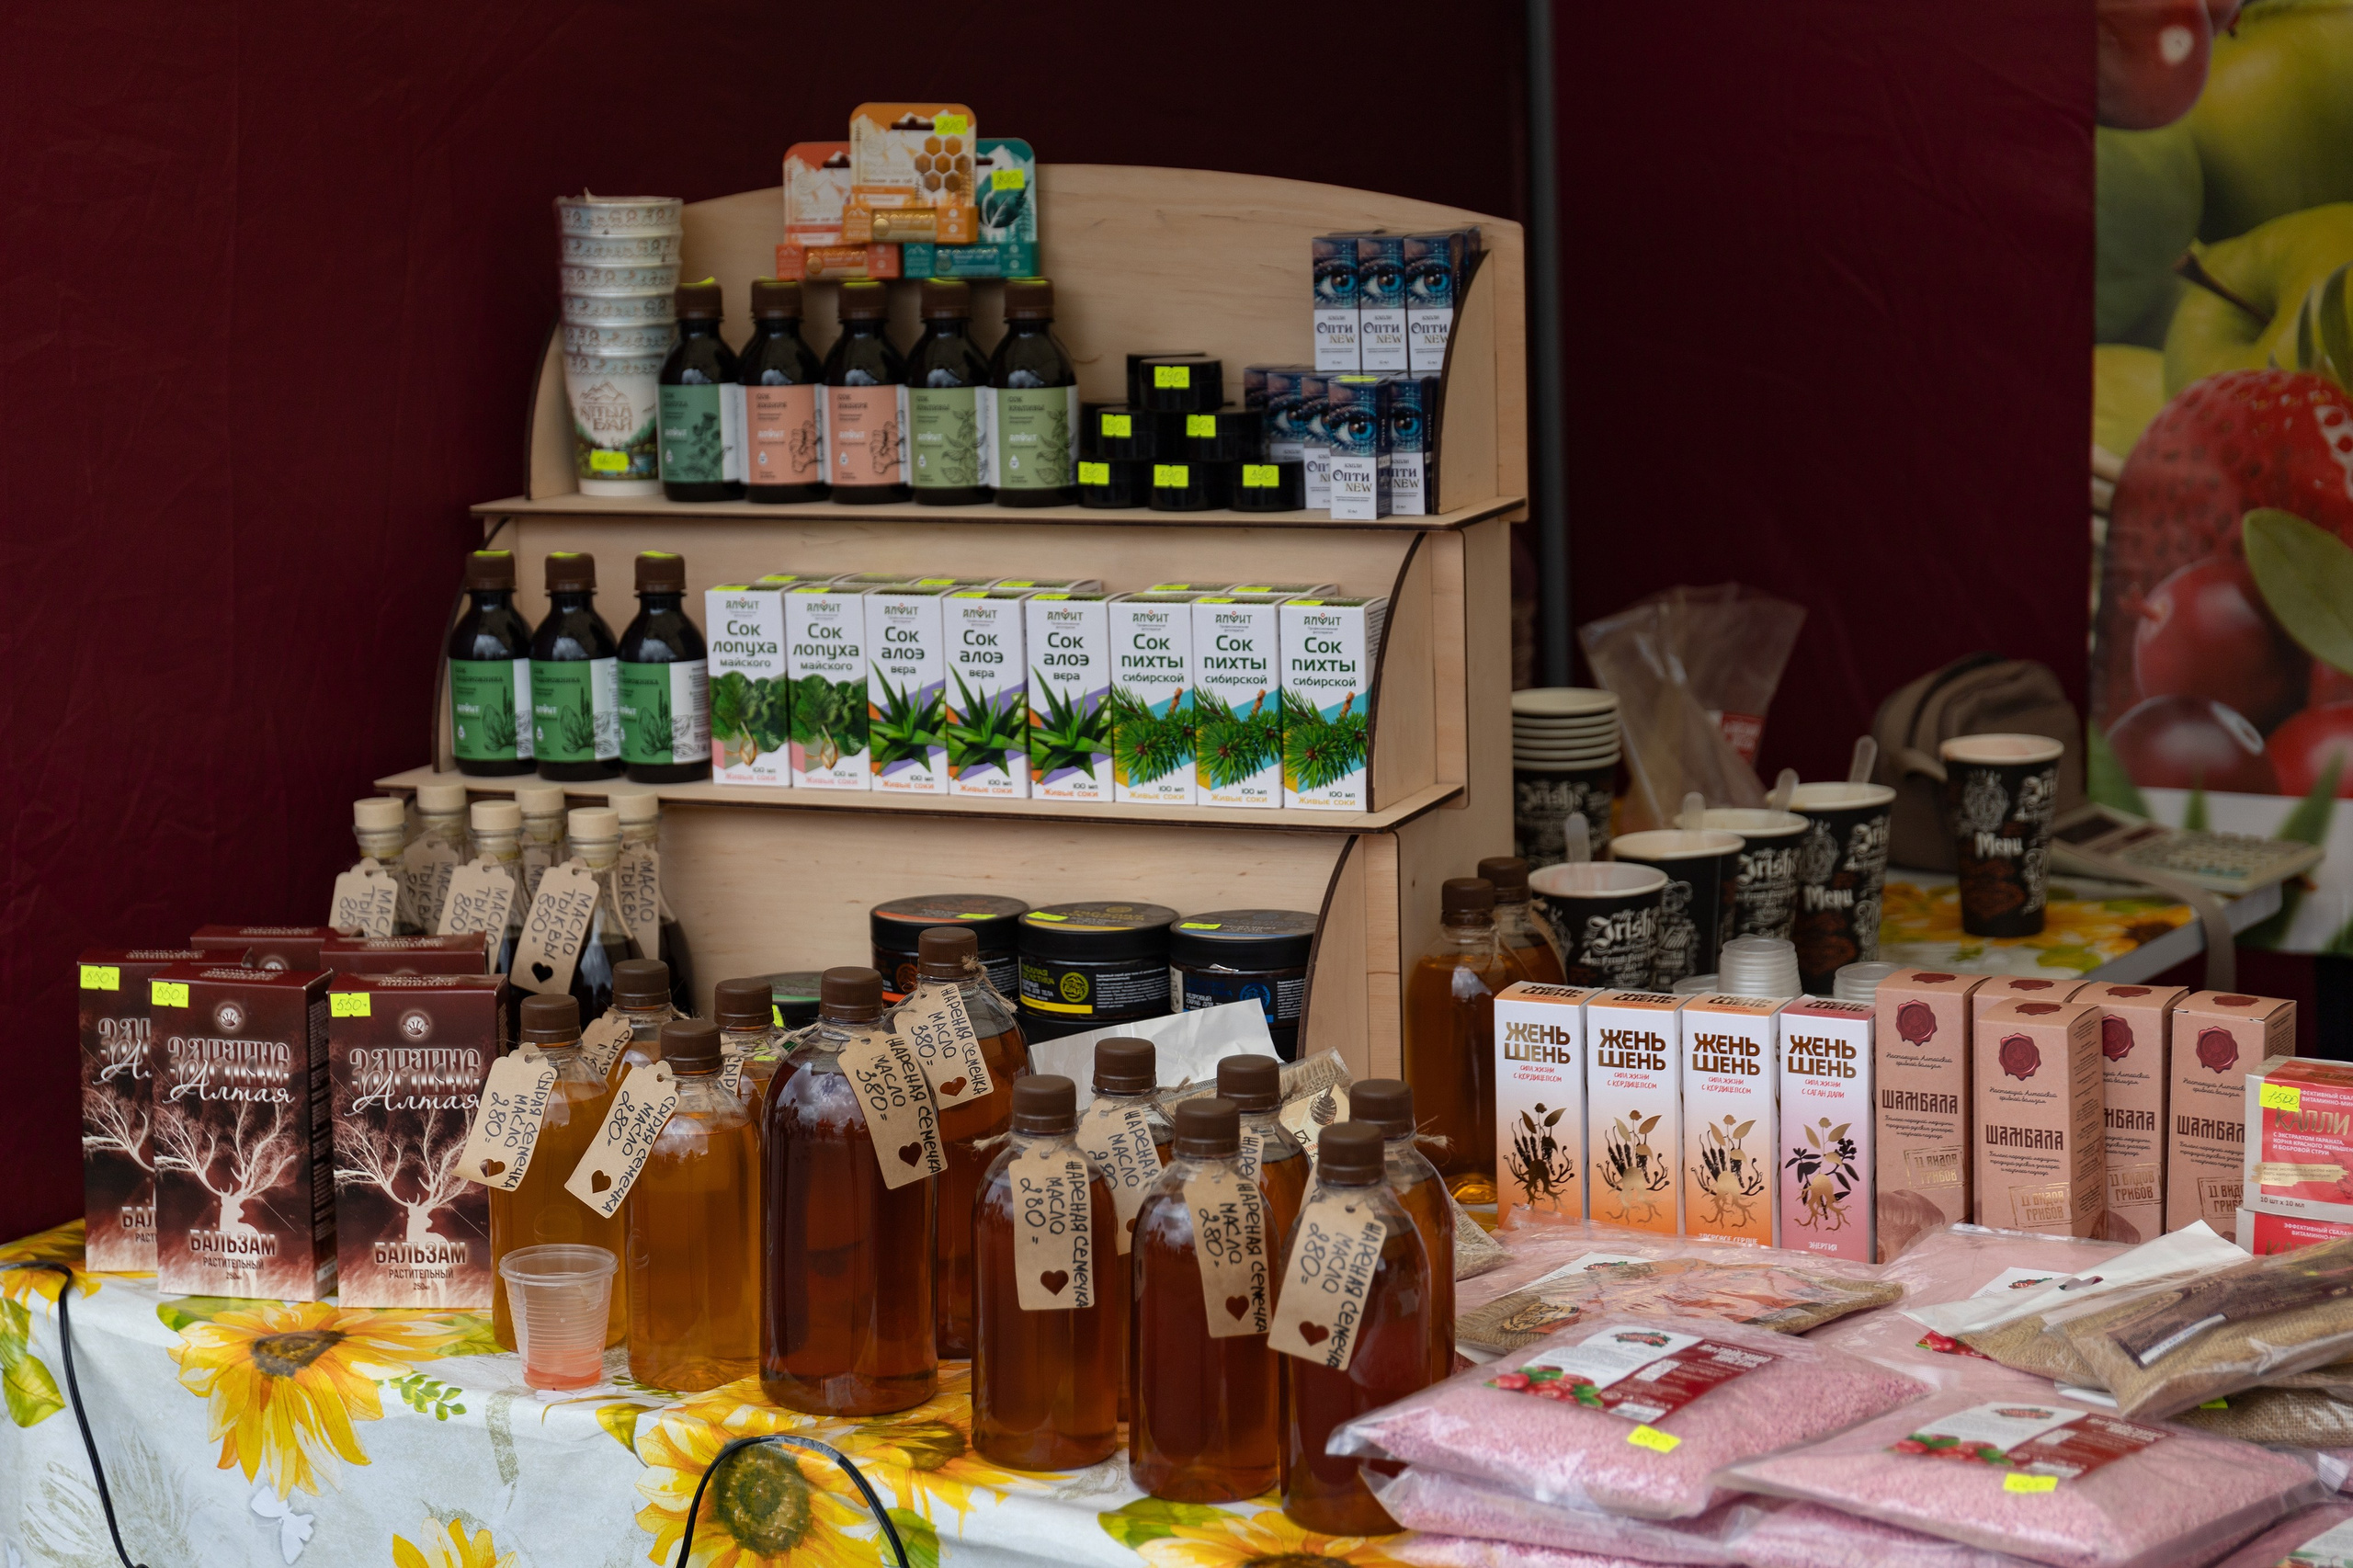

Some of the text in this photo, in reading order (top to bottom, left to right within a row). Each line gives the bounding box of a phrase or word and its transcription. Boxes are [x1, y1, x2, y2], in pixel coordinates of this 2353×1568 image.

[727, 621, 760, 636] Сок
[808, 623, 842, 639] Сок
[885, 627, 919, 642] Сок
[963, 631, 998, 645] Сок
[1048, 632, 1084, 648] Сок
[1133, 633, 1170, 650] Сок
[1216, 635, 1253, 651] Сок
[1304, 637, 1342, 653] Сок
[713, 641, 778, 656] лопуха
[793, 643, 859, 659] лопуха
[881, 646, 925, 660] алоэ
[720, 658, 771, 667] майского
[960, 650, 1003, 664] алоэ
[1044, 653, 1089, 666] алоэ
[1121, 655, 1184, 668] пихты
[1204, 656, 1267, 670] пихты
[801, 661, 853, 671] майского
[891, 665, 916, 675] вера
[1292, 658, 1356, 672] пихты
[969, 669, 995, 678] вера
[1053, 672, 1080, 682] вера
[1122, 672, 1184, 684] сибирской
[1205, 674, 1267, 686] сибирской
[1292, 676, 1357, 687] сибирской
[1044, 789, 1074, 797] Живые
[1299, 796, 1331, 805] Живые
[1975, 832, 2022, 858] Menu
[1803, 884, 1854, 911] Menu
[1505, 1022, 1571, 1045] ЖЕНЬ
[1598, 1028, 1666, 1051] ЖЕНЬ
[1693, 1033, 1761, 1054] ЖЕНЬ
[1789, 1035, 1857, 1058] ЖЕНЬ
[1505, 1042, 1571, 1064] ШЕНЬ
[1598, 1050, 1665, 1071] ШЕНЬ
[1692, 1053, 1761, 1075] ШЕНЬ
[1788, 1057, 1857, 1078] ШЕНЬ
[162, 1059, 295, 1103] Алтая
[344, 1070, 480, 1117] Алтая
[1882, 1089, 1958, 1114] ШАМБАЛА
[2177, 1115, 2245, 1142] ШАМБАЛ
[2276, 1108, 2349, 1136] КАПЛИ
[1986, 1124, 2063, 1150] ШАМБАЛА
[2279, 1132, 2314, 1141] ЭКСТРАКТОМ
[2026, 1206, 2063, 1221] ГРИБОВ
[2284, 1223, 2327, 1233] ЭФФЕКТИВНЫЙ
[189, 1229, 276, 1256] БАЛЬЗАМ
[1809, 1241, 1837, 1251] ЭНЕРГИЯ
[374, 1241, 467, 1265] БАЛЬЗАМ
[203, 1256, 264, 1270] РАСТИТЕЛЬНЫЙ
[388, 1267, 454, 1279] РАСТИТЕЛЬНЫЙ
